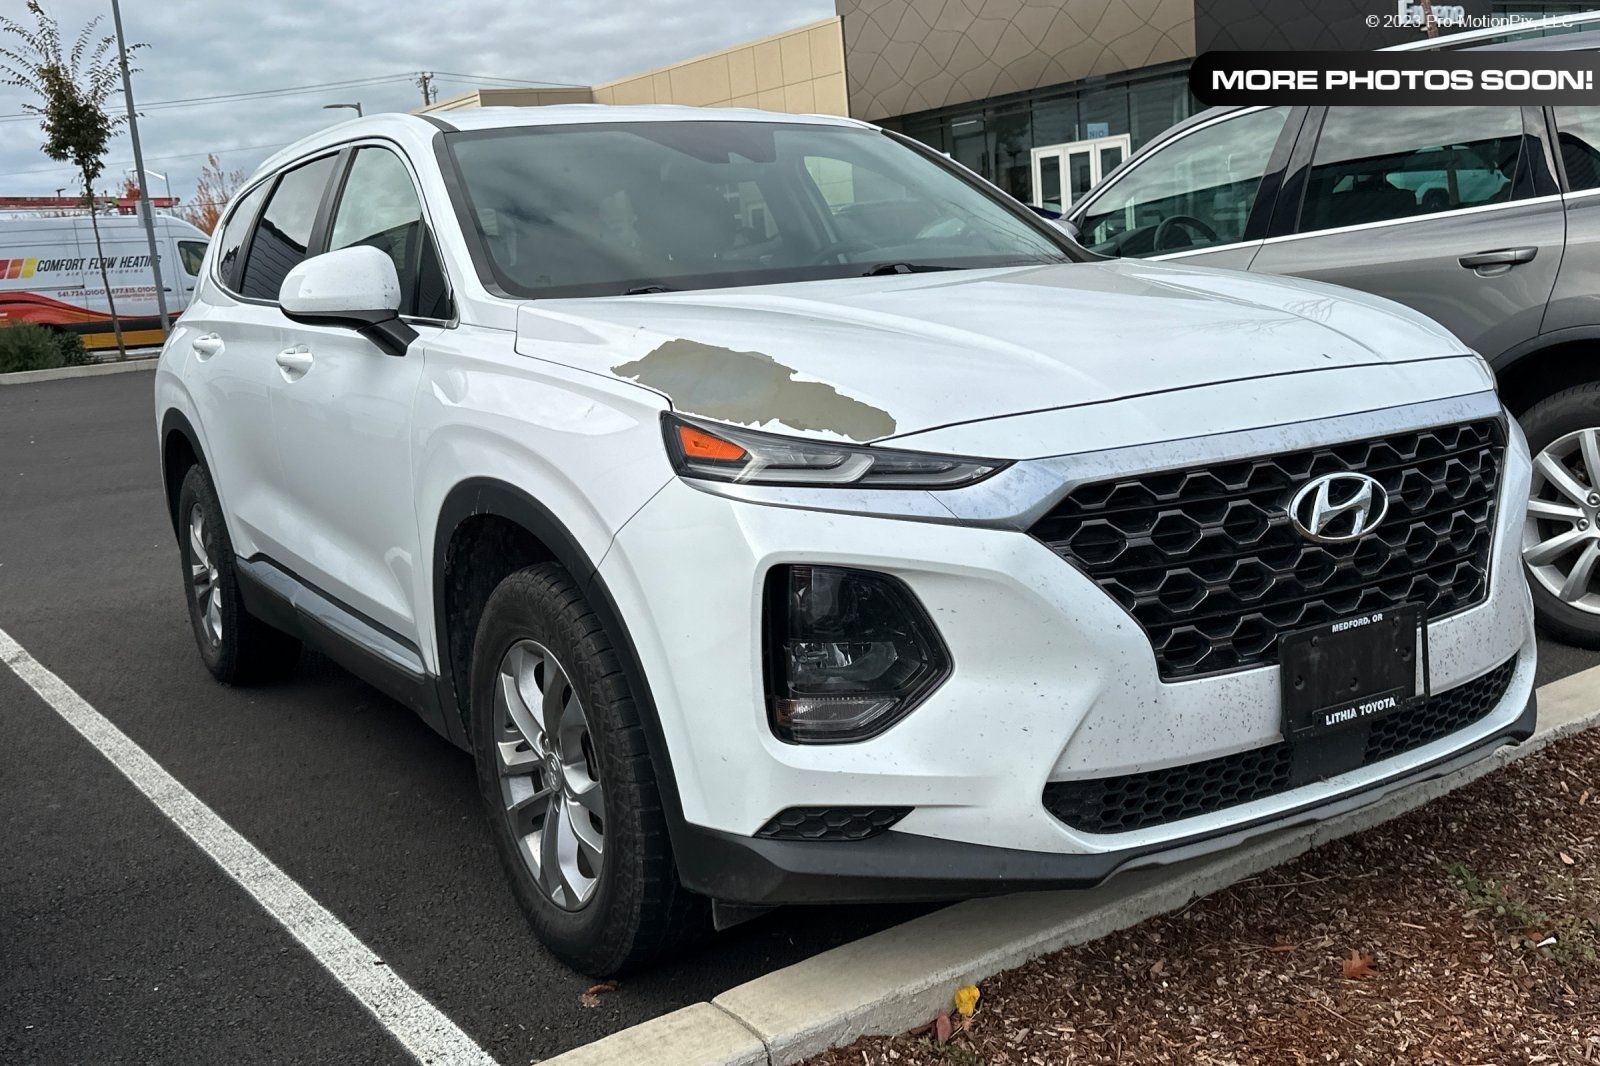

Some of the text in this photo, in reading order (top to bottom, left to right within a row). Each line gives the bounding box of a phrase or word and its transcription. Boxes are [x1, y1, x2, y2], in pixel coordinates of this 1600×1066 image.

[36, 258, 86, 272] COMFORT
[88, 256, 118, 270] FLOW
[1332, 613, 1383, 632] MEDFORD, OR
[1325, 697, 1396, 725] LITHIA TOYOTA
